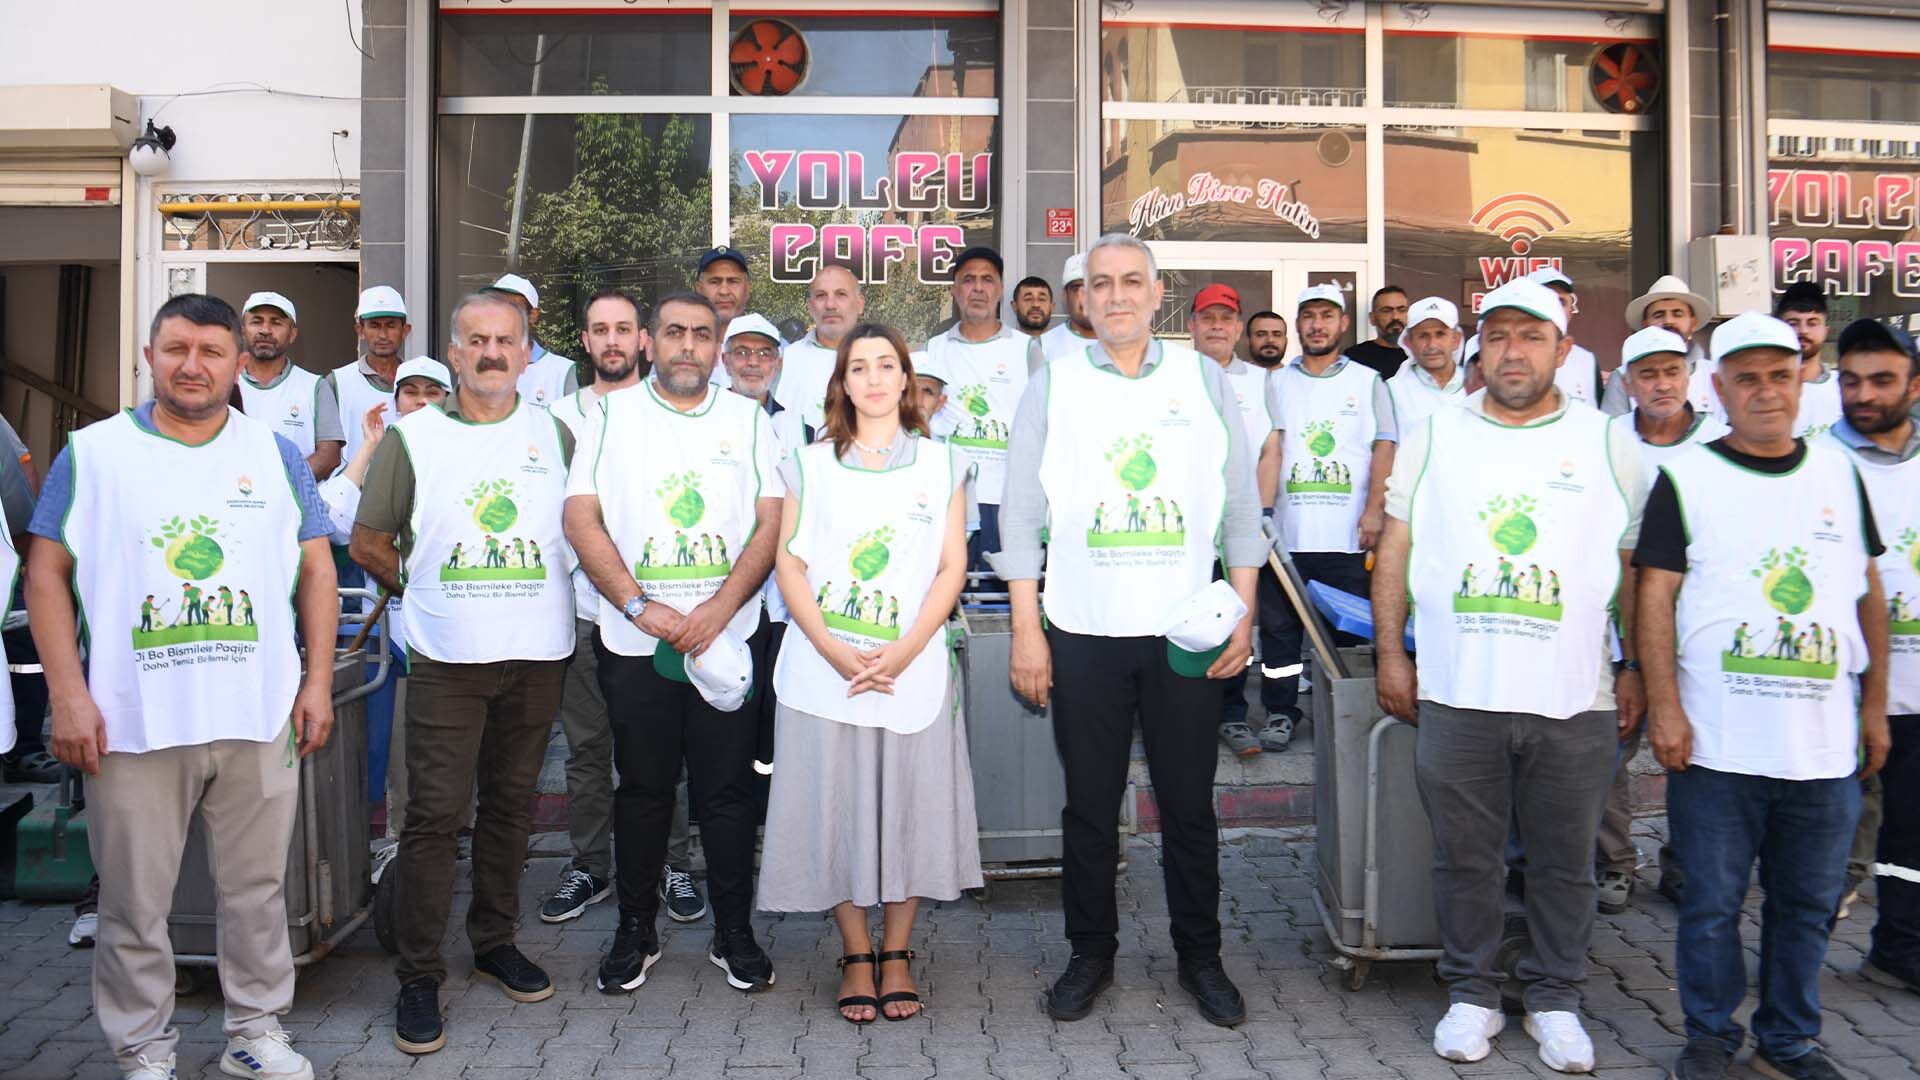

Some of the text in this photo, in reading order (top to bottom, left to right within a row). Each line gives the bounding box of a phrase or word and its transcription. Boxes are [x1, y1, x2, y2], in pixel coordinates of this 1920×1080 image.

[744, 151, 992, 212] YOLCU
[1256, 178, 1320, 239] Hatin
[1768, 169, 1920, 230] YOLC
[770, 223, 966, 284] CAFE
[1771, 237, 1920, 297] CAFE
[440, 583, 449, 591] Ji
[451, 583, 464, 591] Bo
[466, 582, 512, 591] Bismileke
[135, 652, 145, 662] Ji
[148, 650, 164, 661] Bo
[215, 642, 257, 655] Paqijtir
[143, 661, 169, 672] Daha
